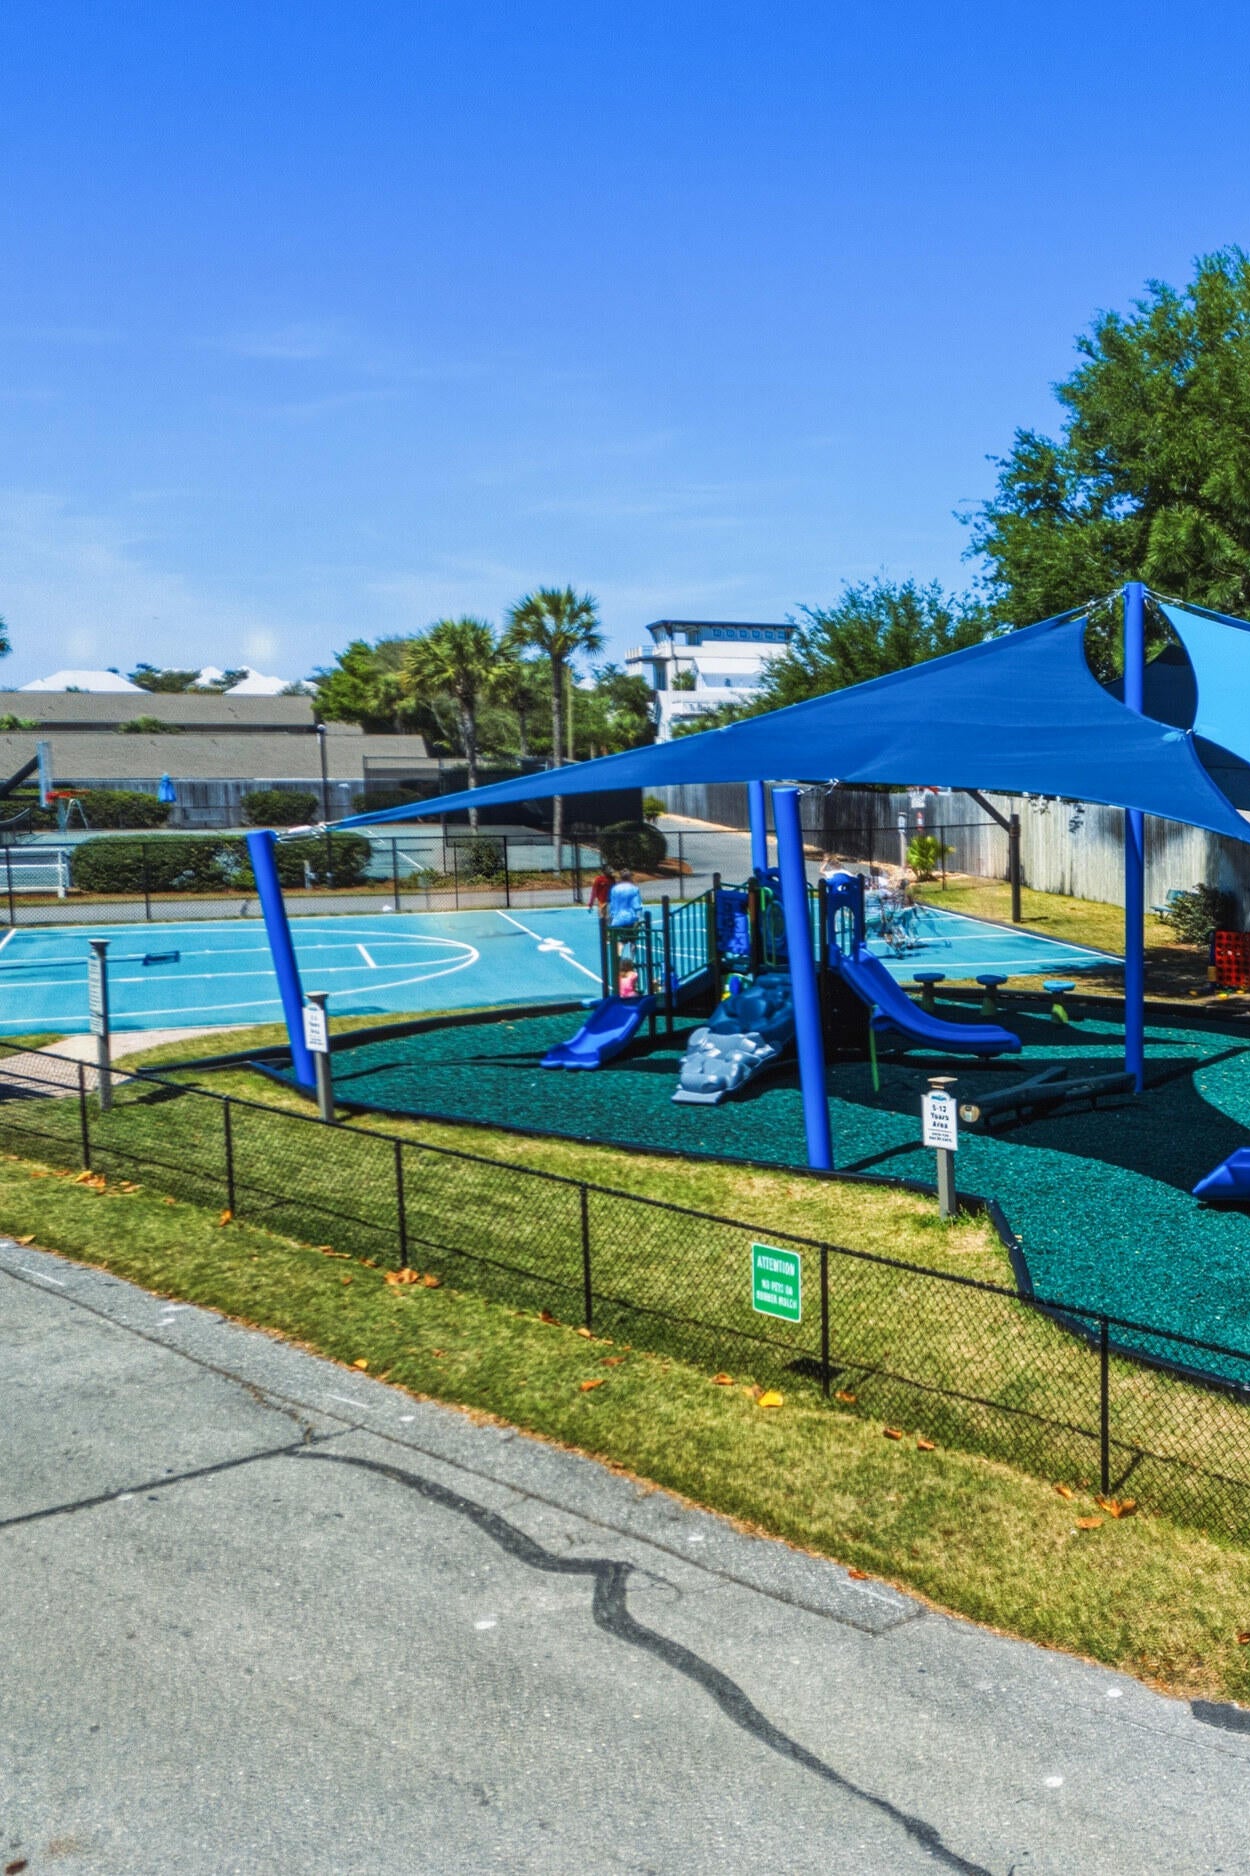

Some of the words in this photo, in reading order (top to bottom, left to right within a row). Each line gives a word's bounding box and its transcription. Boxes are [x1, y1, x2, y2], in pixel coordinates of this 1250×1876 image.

[930, 1112, 949, 1121] Years
[932, 1120, 948, 1129] Area
[757, 1255, 795, 1276] ATTENTION
